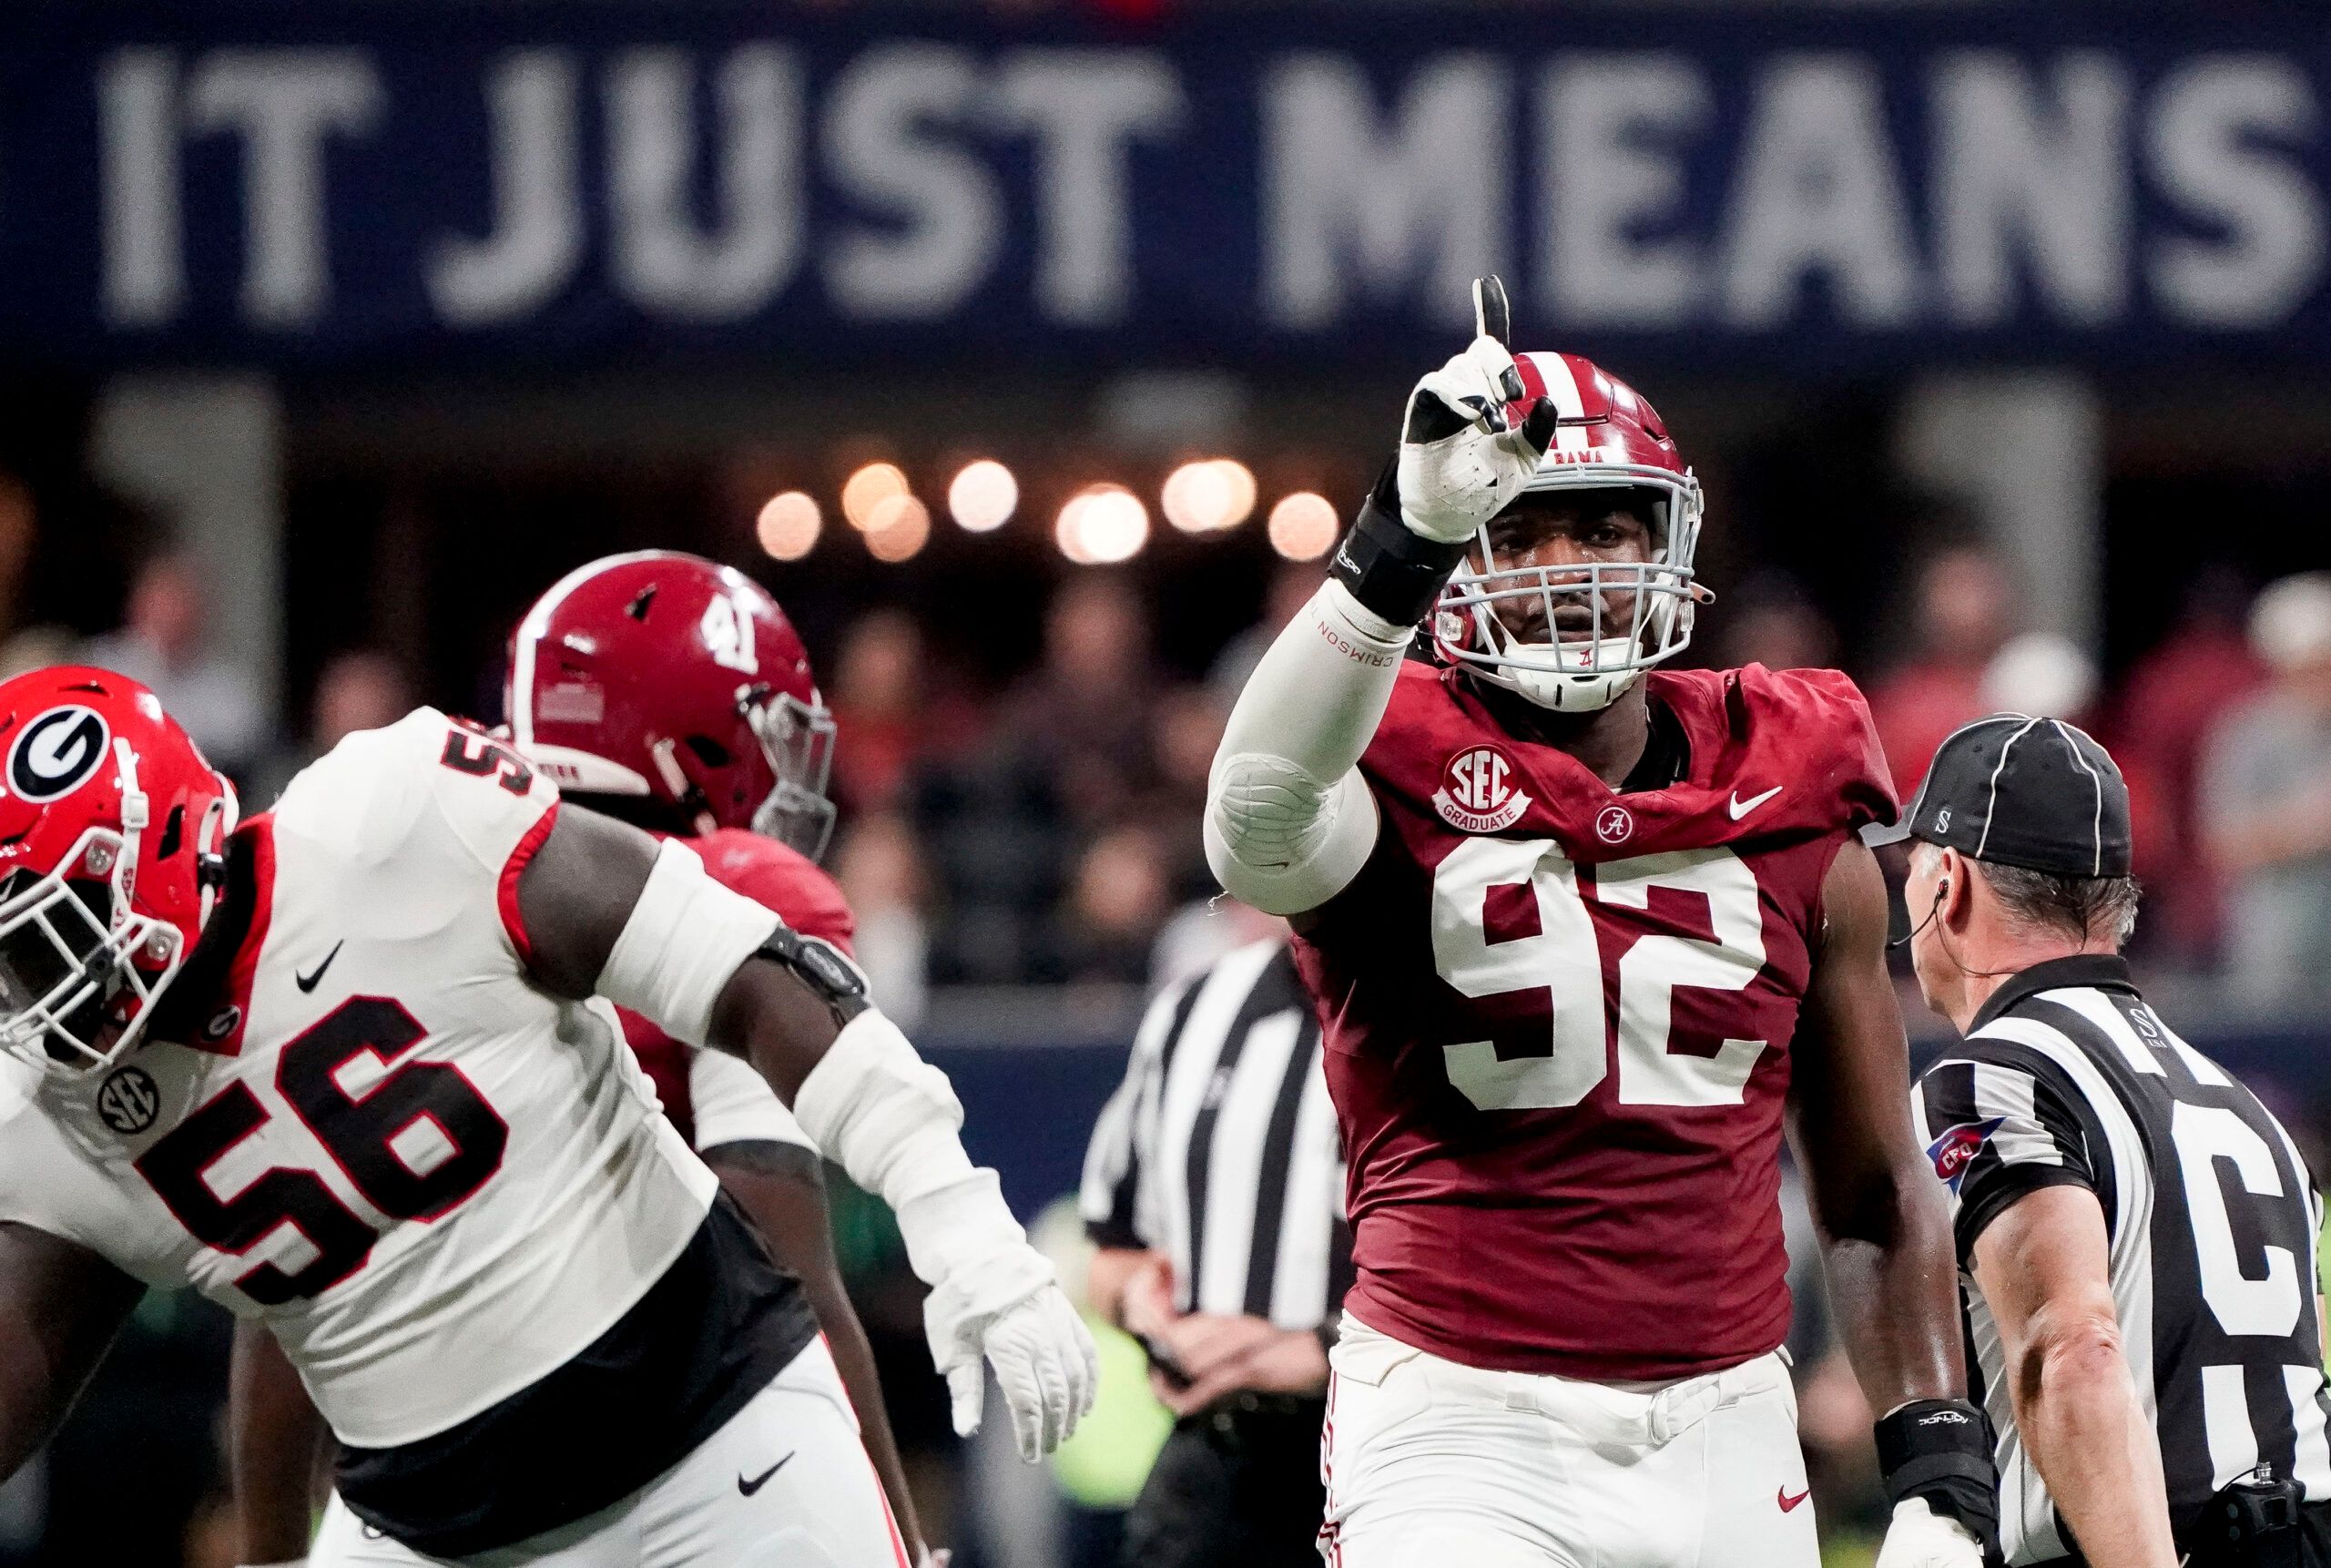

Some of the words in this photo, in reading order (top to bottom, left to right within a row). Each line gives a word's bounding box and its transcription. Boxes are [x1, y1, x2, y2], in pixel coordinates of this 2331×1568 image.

[98, 47, 386, 330] IT
[422, 44, 1186, 326] JUST
[1260, 50, 2326, 329] MEANS
[1317, 621, 1394, 667] CRIMSON
[13, 709, 104, 798] G
[1451, 749, 1512, 809] SEC
[1442, 803, 1517, 831] GRADUATE
[1597, 809, 1628, 839] A
[1431, 836, 1767, 1111] 92
[100, 1072, 156, 1130] SEC
[133, 993, 510, 1306] 56
[2172, 1100, 2303, 1338] C
